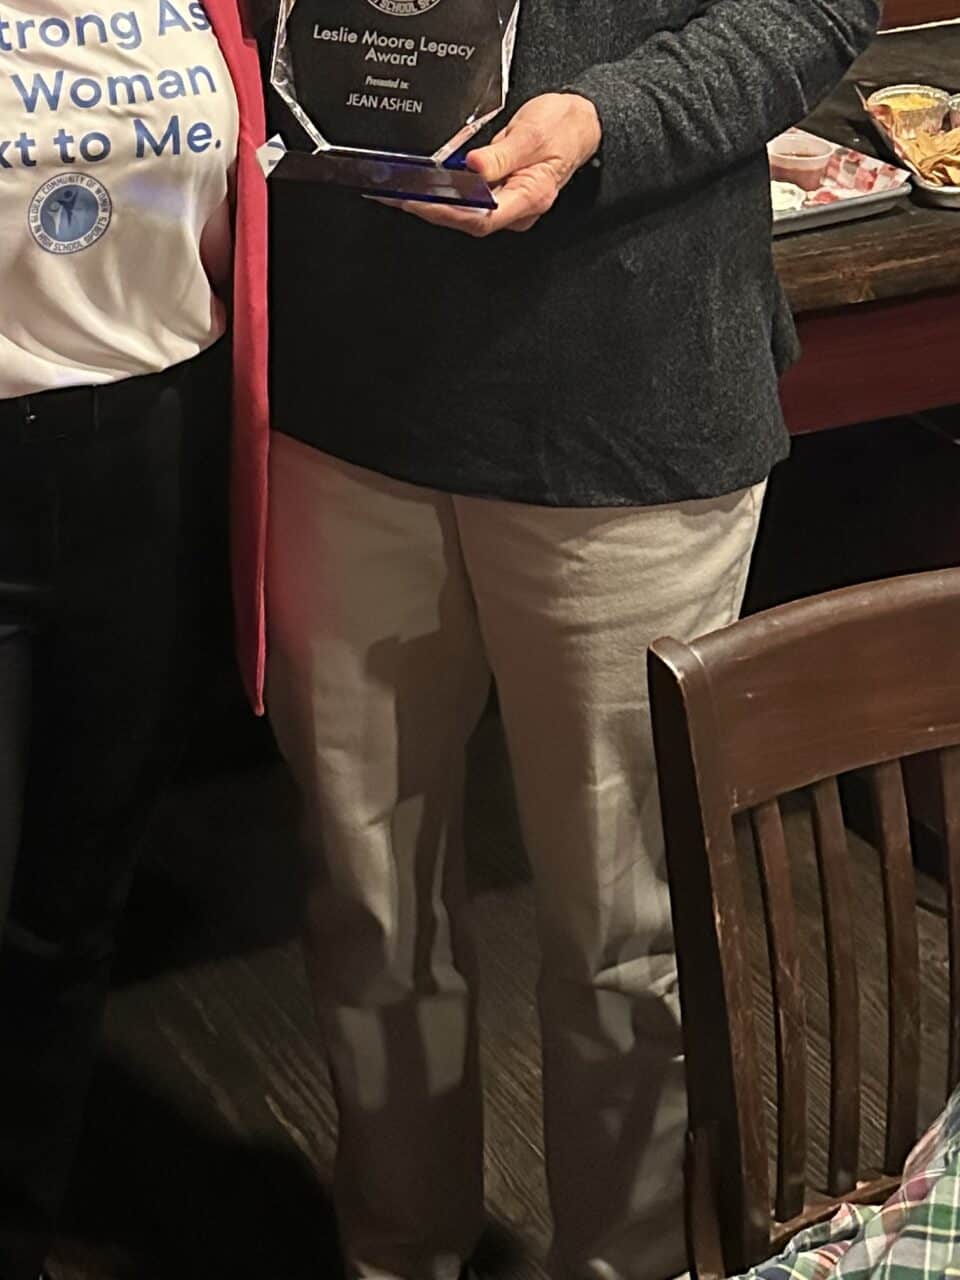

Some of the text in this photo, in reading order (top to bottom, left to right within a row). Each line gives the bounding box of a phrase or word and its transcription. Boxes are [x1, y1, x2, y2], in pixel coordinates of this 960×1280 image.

[313, 24, 475, 60] Leslie Moore Legacy
[364, 47, 418, 66] Award
[10, 65, 217, 113] Woman
[346, 93, 423, 113] JEAN ASHEN
[53, 128, 111, 164] to
[132, 115, 221, 159] Me.
[53, 241, 84, 251] SCHOOL
